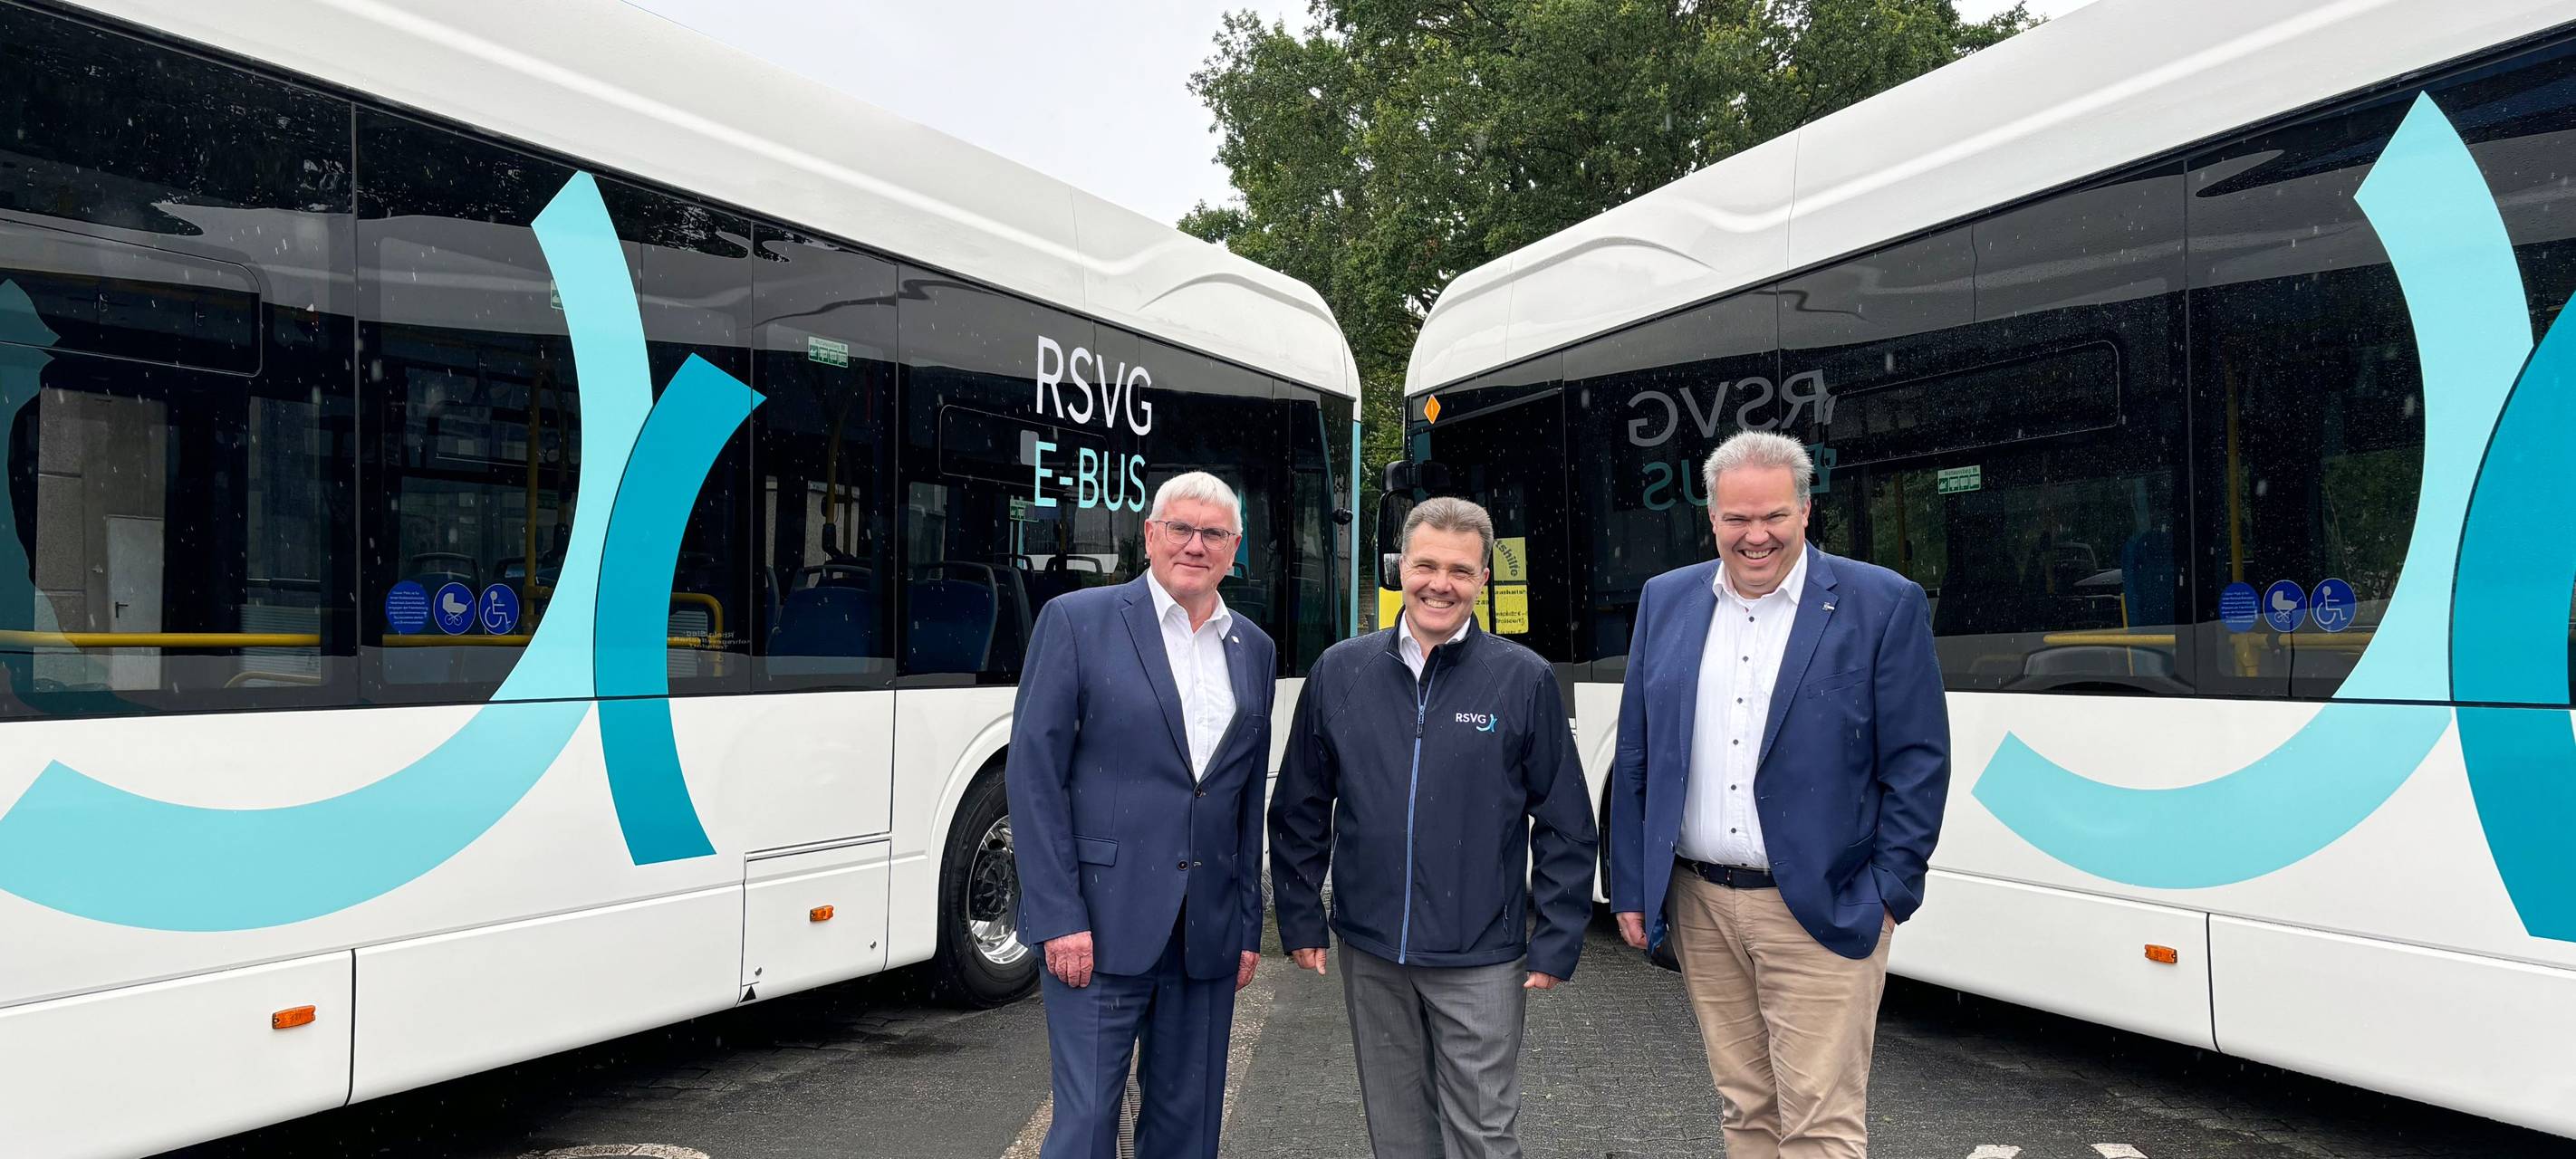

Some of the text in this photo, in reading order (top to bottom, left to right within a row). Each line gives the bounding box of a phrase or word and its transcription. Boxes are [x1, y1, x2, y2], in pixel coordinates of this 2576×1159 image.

[1036, 335, 1152, 436] RSVG
[1034, 441, 1146, 512] E-BUS
[1492, 538, 1519, 577] tshilfe
[1456, 713, 1486, 723] RSVG
